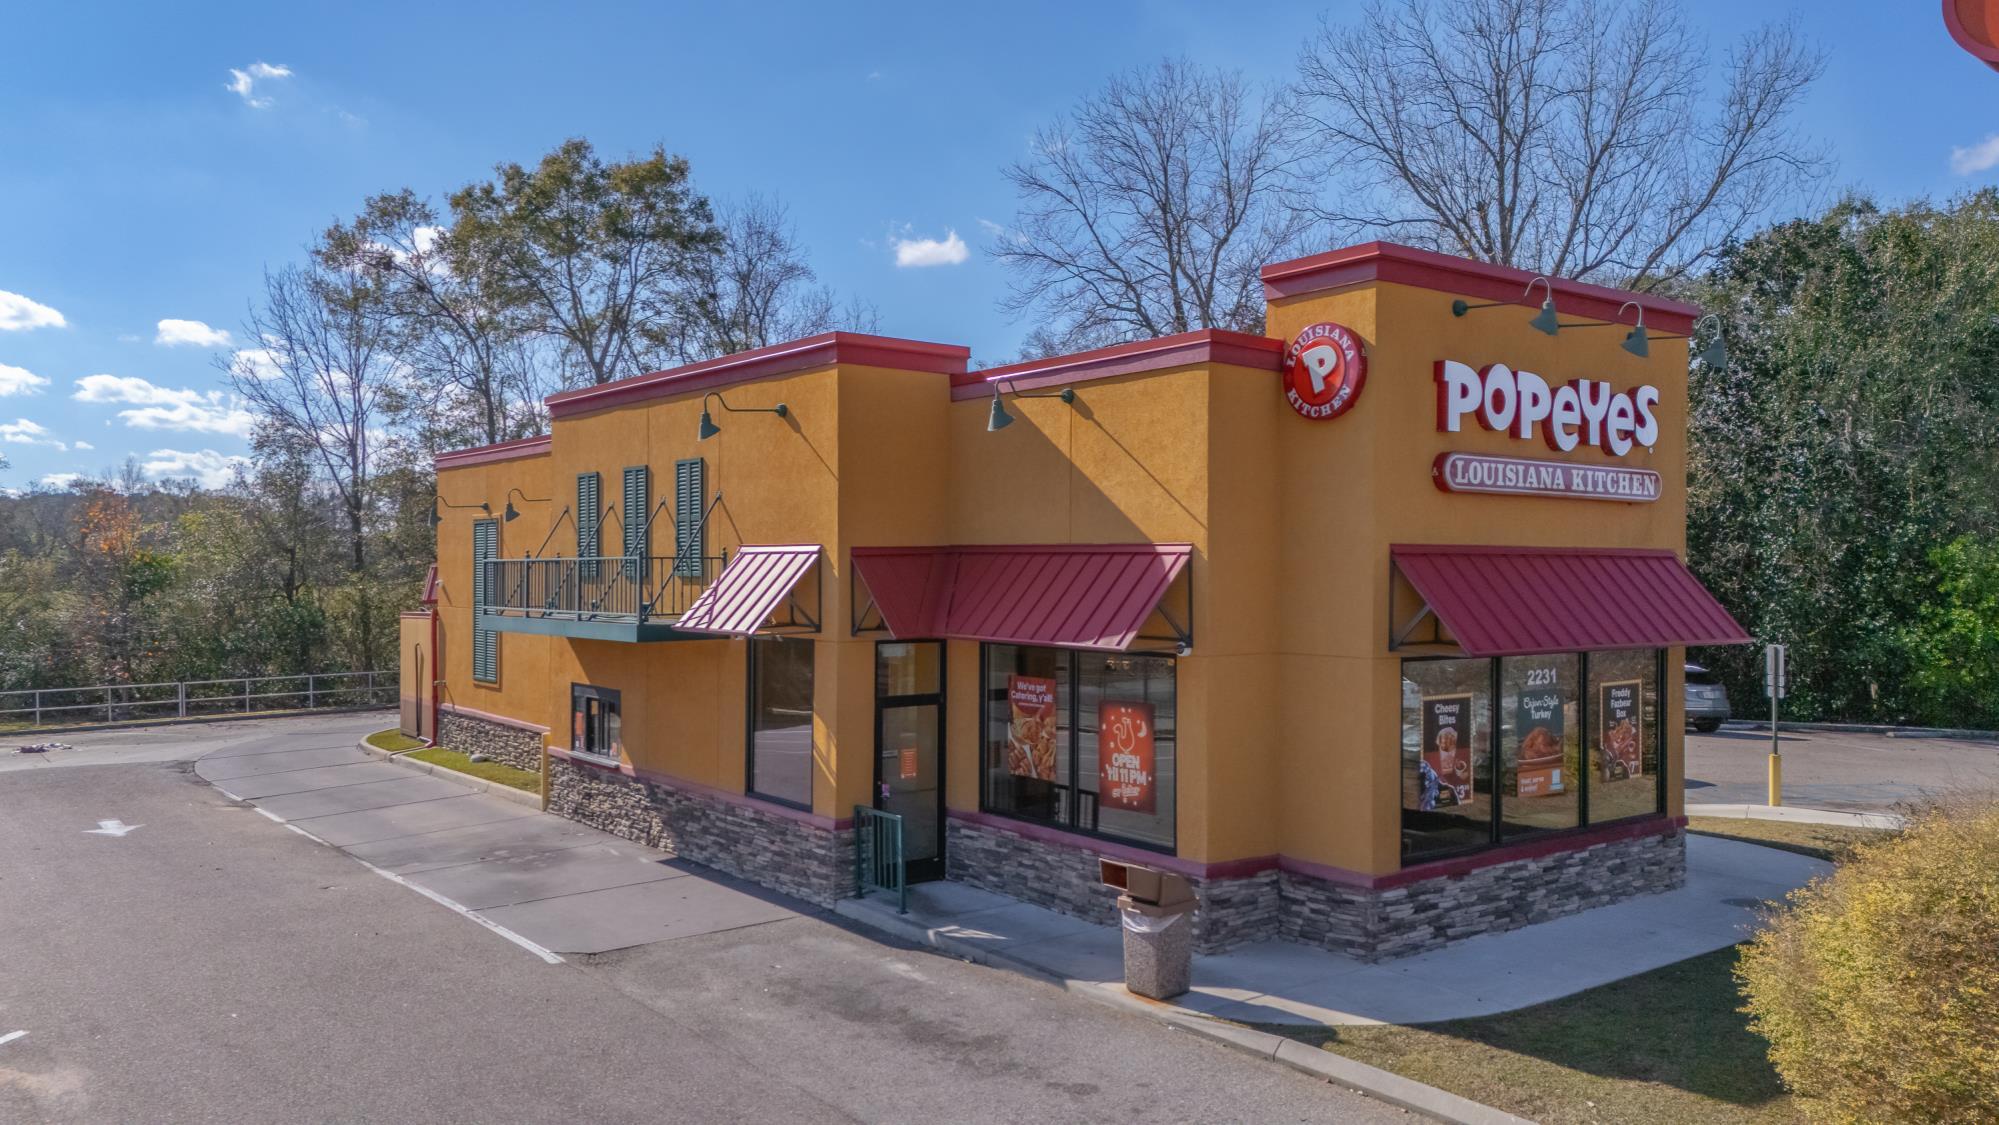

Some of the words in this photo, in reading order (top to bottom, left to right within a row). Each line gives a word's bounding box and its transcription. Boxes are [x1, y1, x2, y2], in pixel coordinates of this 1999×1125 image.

[1287, 325, 1354, 368] LOUISIANA
[1302, 344, 1338, 394] P
[1286, 384, 1351, 417] KITCHEN
[1455, 460, 1566, 490] LOUISIANA
[1571, 470, 1657, 496] KITCHEN
[1527, 667, 1557, 686] 2231
[1611, 688, 1631, 698] Freddy
[1531, 709, 1552, 720] Turkey
[1112, 752, 1140, 769] OPEN
